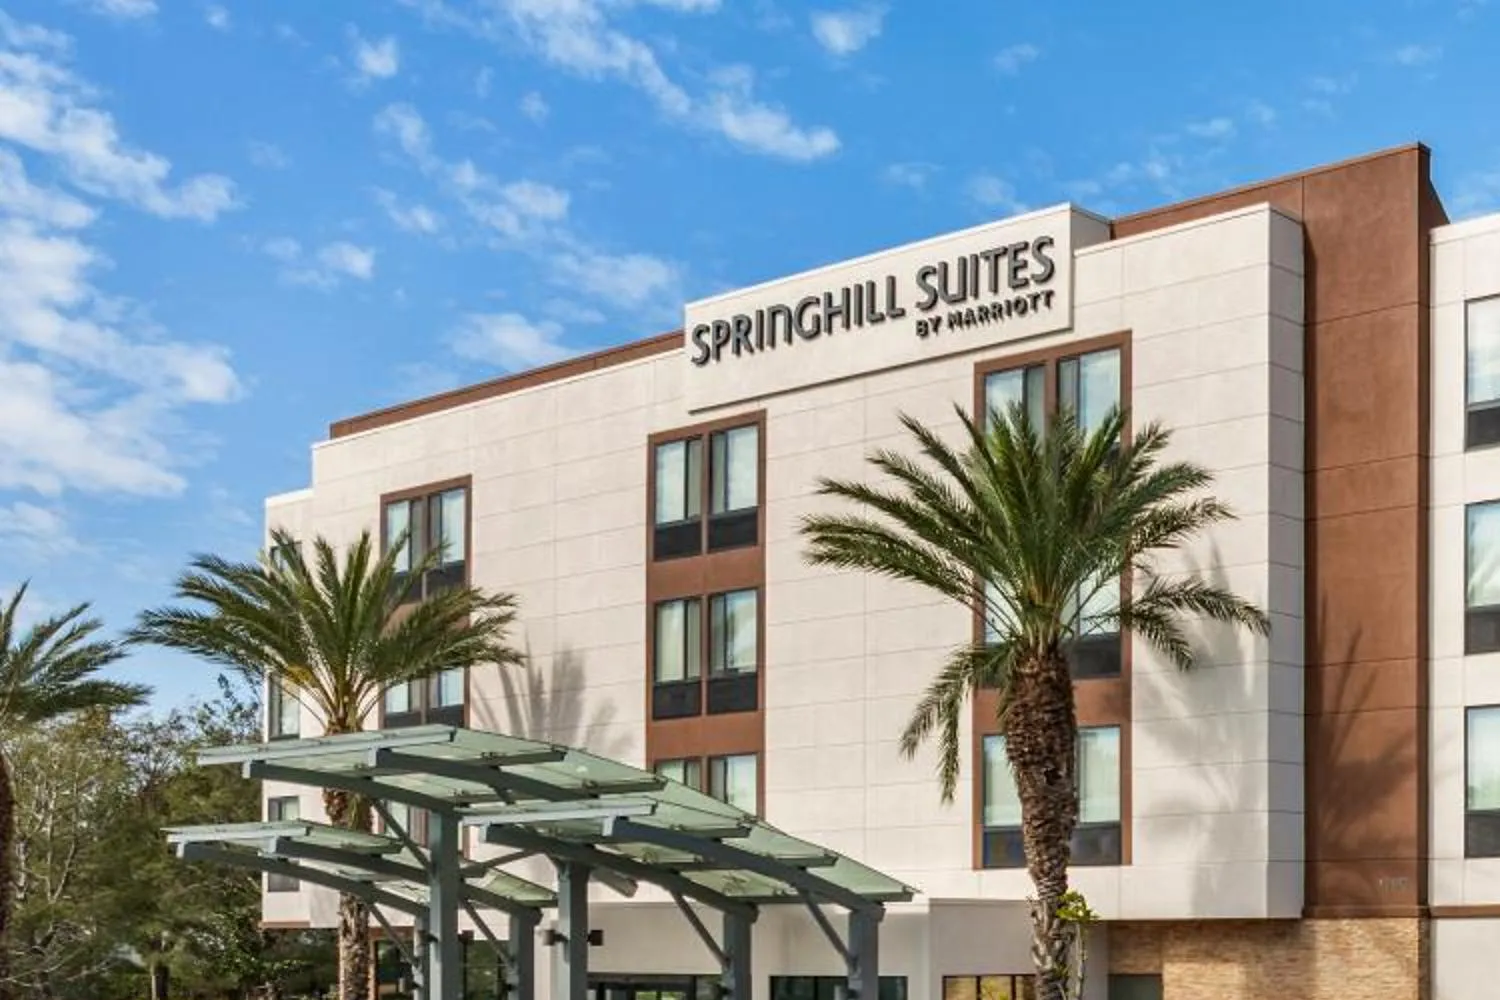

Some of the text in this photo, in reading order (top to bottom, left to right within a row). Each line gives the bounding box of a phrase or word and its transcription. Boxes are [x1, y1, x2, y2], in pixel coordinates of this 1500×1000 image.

[691, 235, 1056, 367] SPRINGHILL SUITES
[915, 289, 1055, 338] BY MARRIOTT
